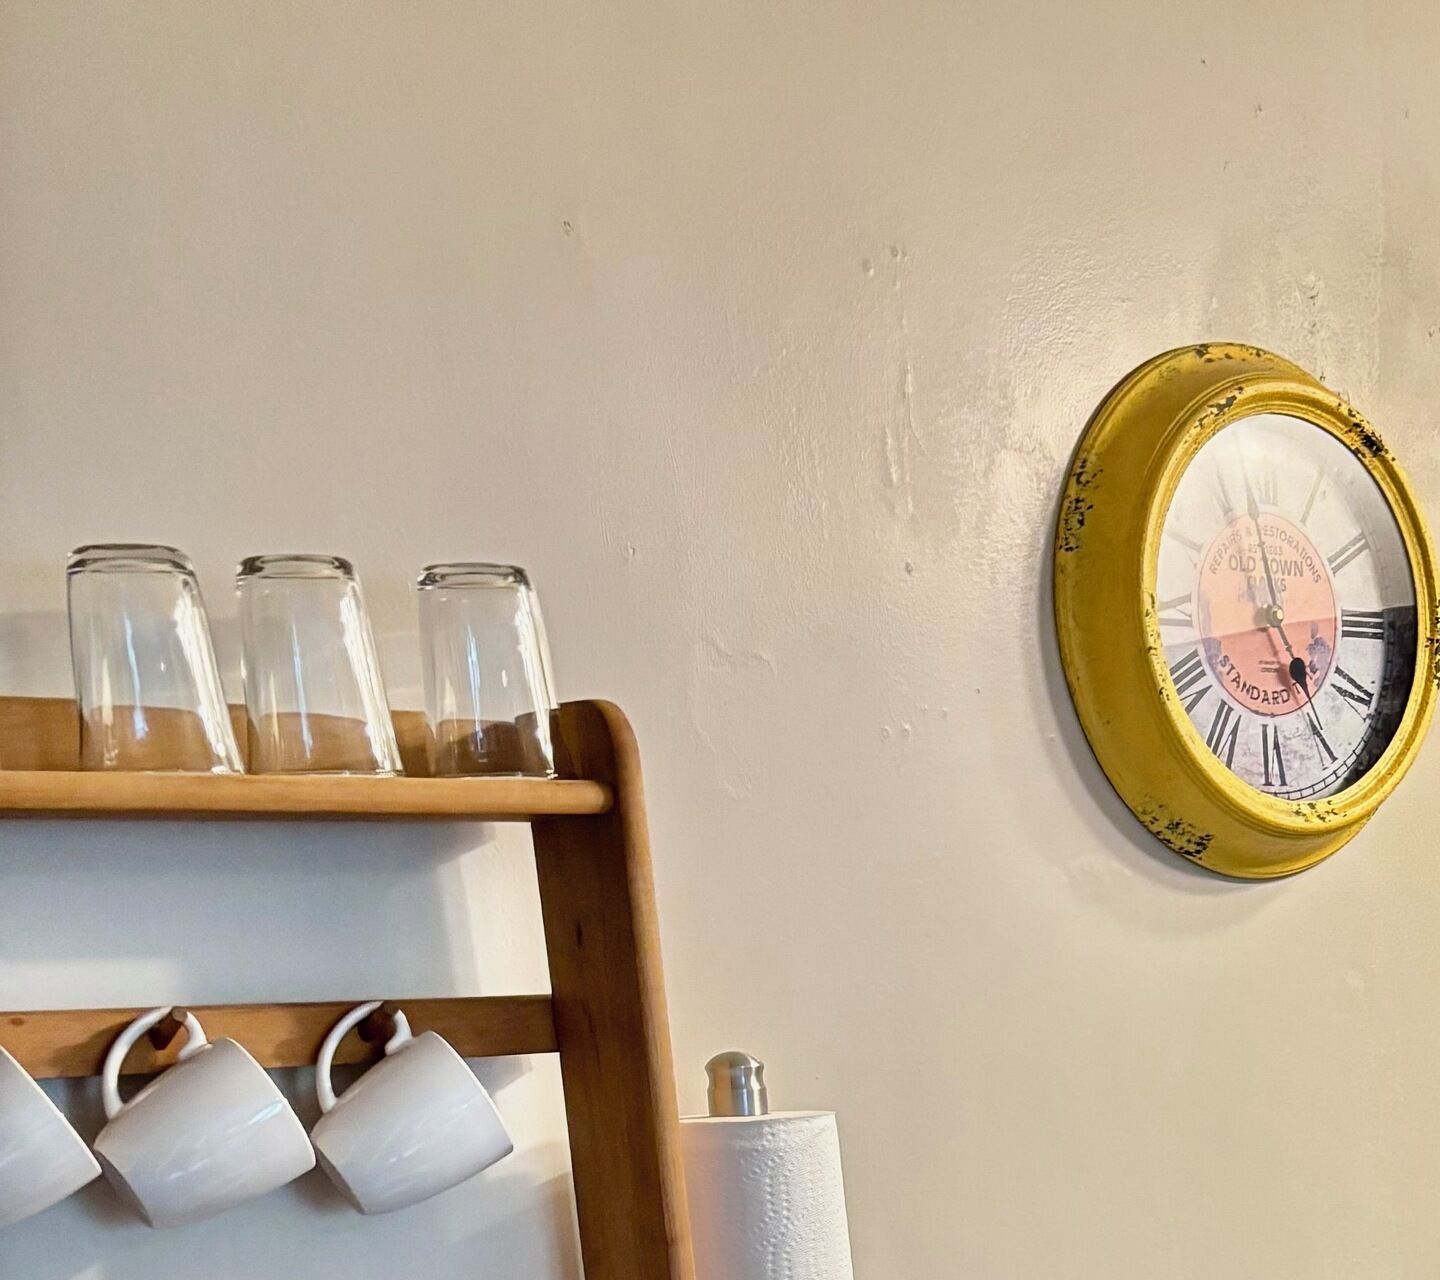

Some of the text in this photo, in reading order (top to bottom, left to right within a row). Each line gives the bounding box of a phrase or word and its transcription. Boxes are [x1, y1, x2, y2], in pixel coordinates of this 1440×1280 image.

[1209, 529, 1242, 575] REPAIRS
[1262, 525, 1322, 584] ESTORATIONS
[1228, 556, 1304, 578] OLD OWN
[1219, 654, 1290, 705] STANDARD
